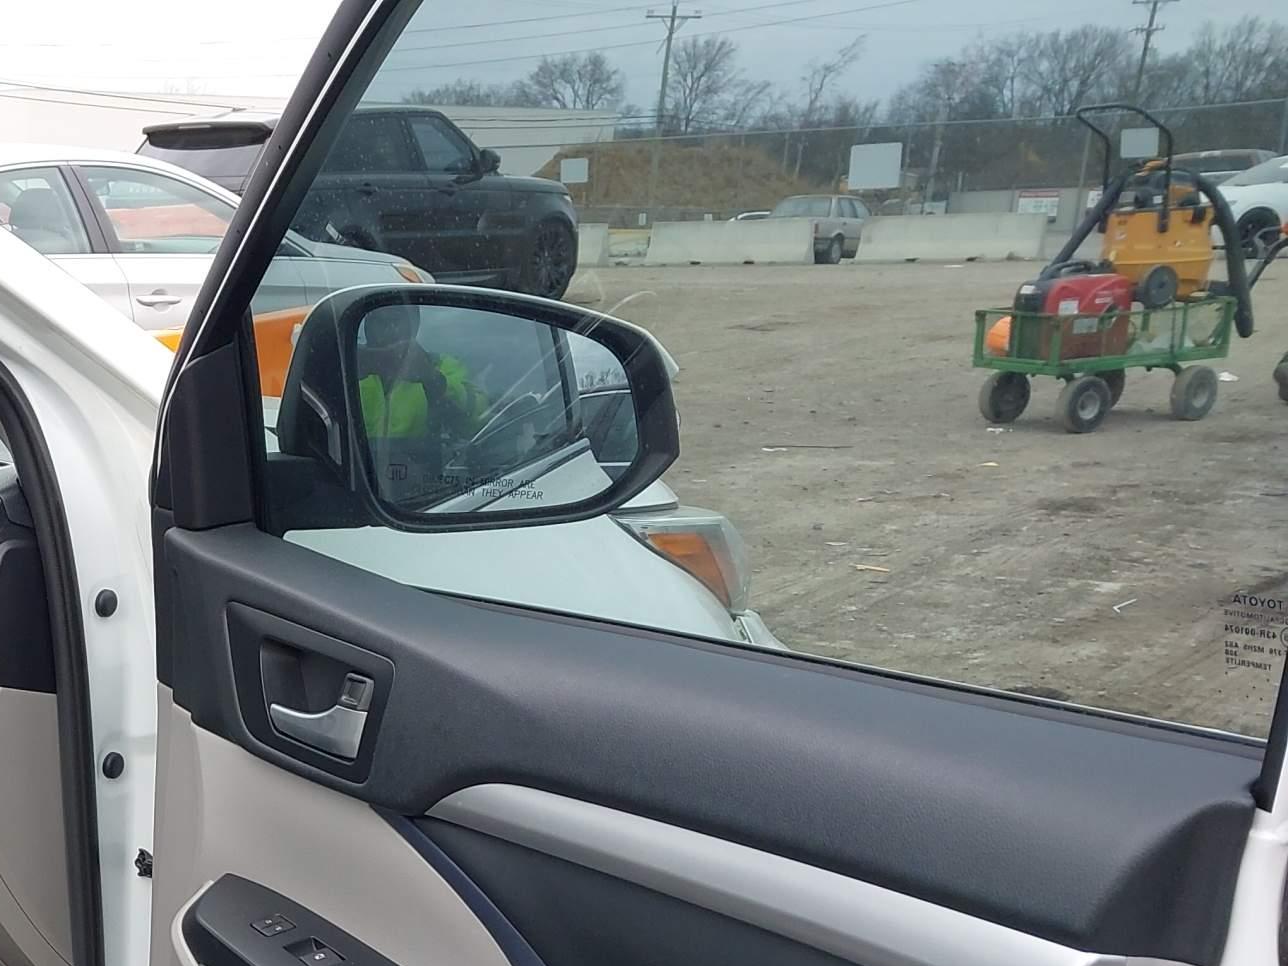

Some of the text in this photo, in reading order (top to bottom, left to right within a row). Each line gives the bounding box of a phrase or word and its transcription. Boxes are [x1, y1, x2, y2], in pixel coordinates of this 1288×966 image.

[519, 479, 536, 489] ARE
[482, 488, 503, 498] THEY
[508, 489, 544, 500] APPEAR
